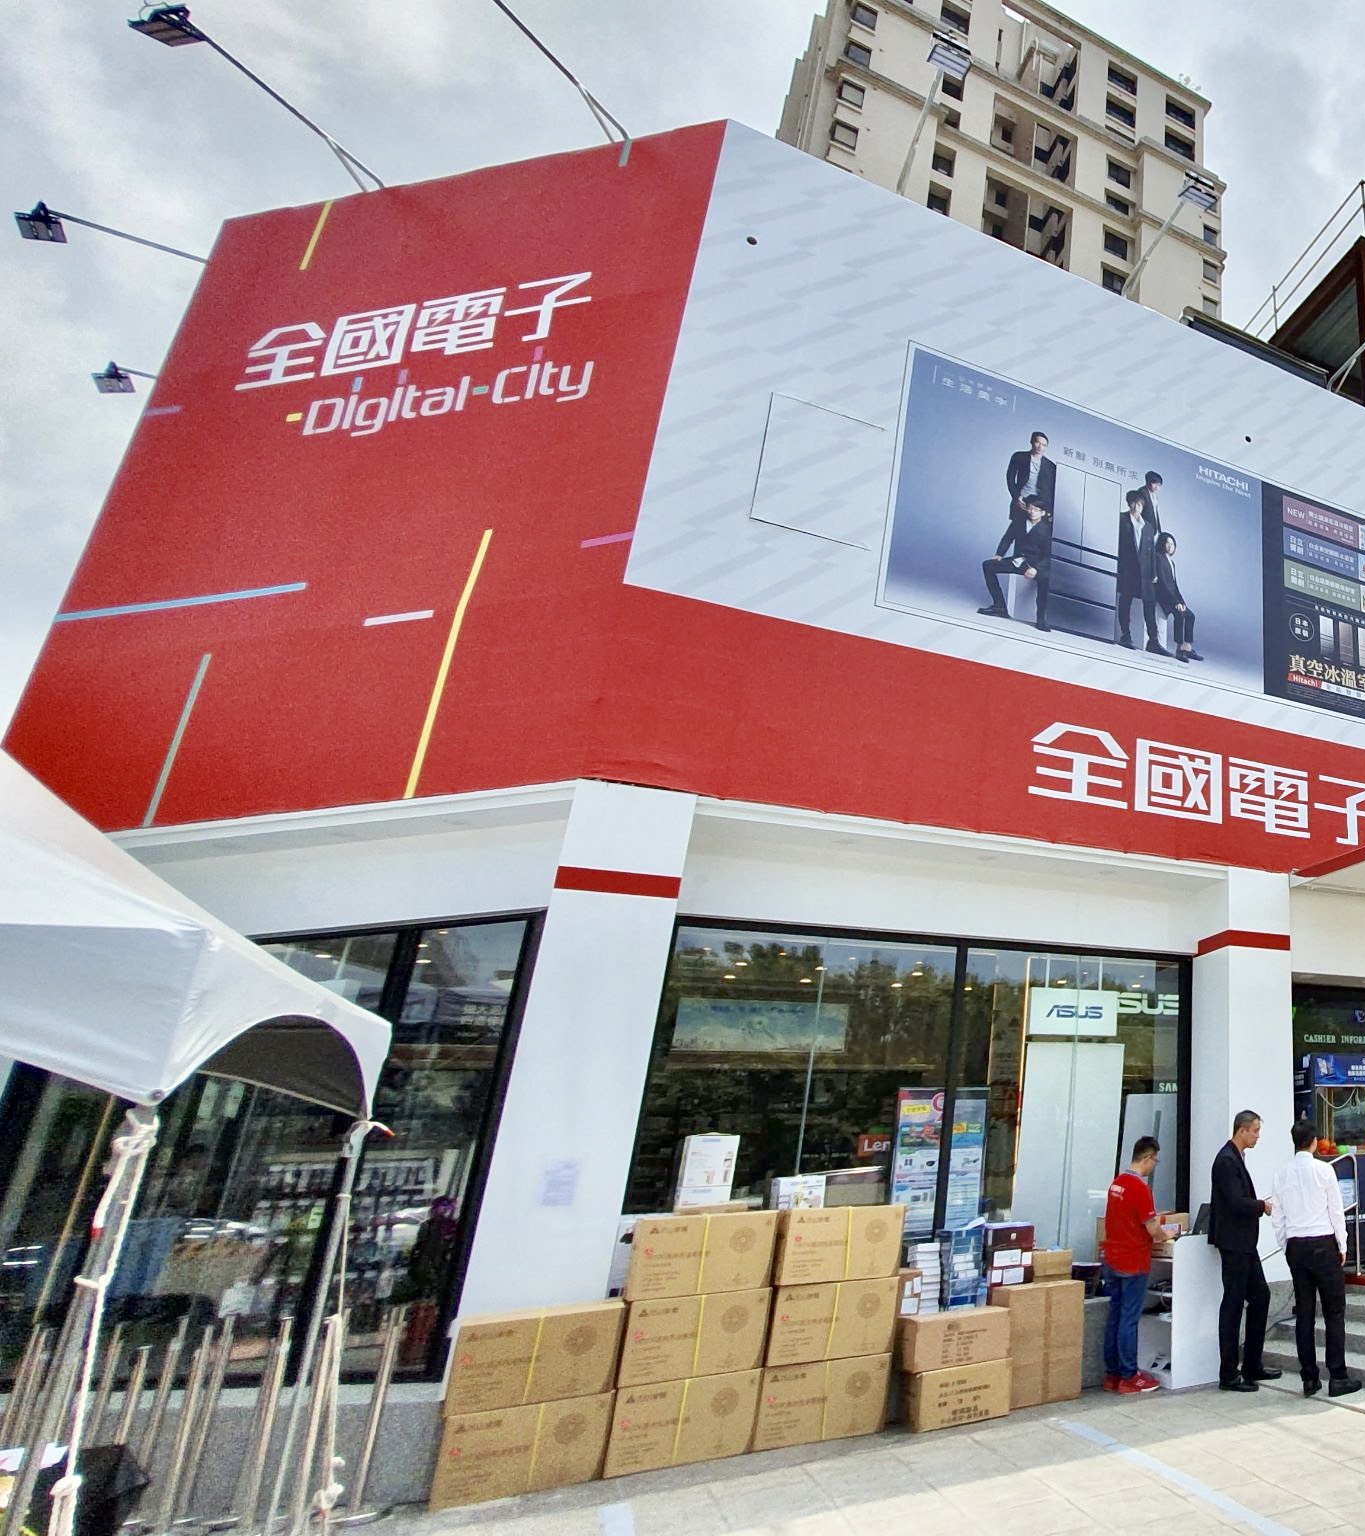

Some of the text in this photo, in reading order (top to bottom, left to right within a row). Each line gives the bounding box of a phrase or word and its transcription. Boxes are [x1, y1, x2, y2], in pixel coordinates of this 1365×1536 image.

[235, 272, 592, 391] 全國電子
[1198, 465, 1249, 491] HITACHI
[1287, 507, 1305, 520] NEW
[1292, 674, 1319, 688] Hitachi
[1046, 1004, 1103, 1020] ASUS
[1304, 1033, 1336, 1044] CASHIER
